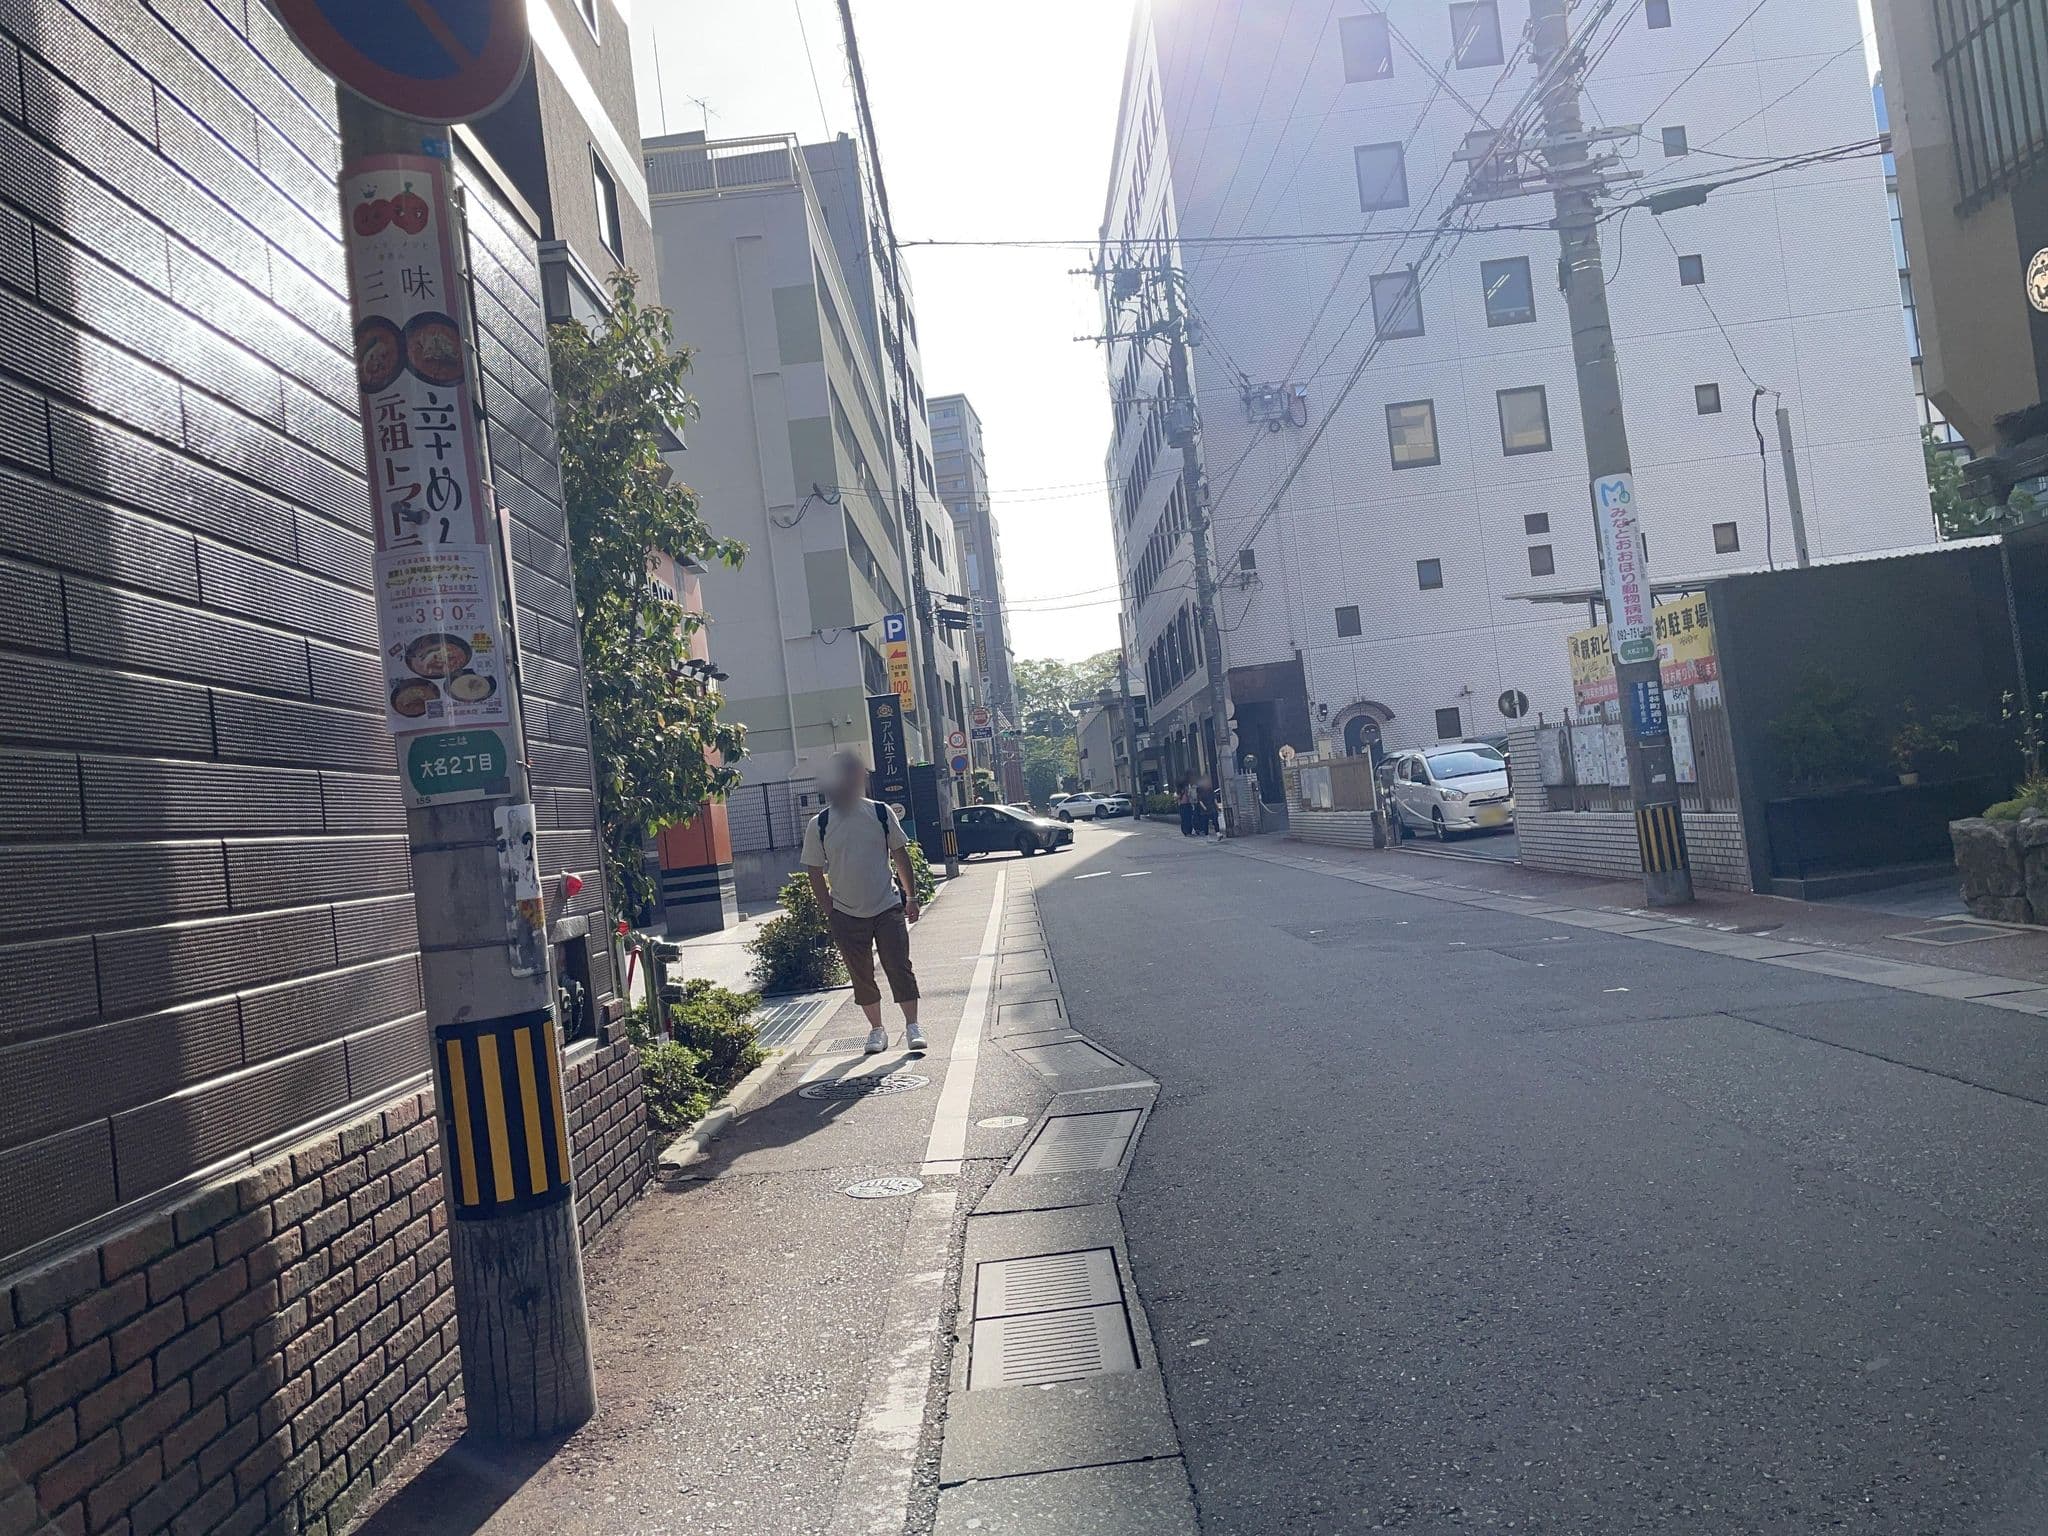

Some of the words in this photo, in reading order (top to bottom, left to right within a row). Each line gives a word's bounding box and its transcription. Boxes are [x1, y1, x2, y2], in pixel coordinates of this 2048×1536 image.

[364, 265, 434, 302] 三味
[1610, 507, 1643, 625] みなとおおほり動物病院
[887, 619, 902, 640] P
[1655, 603, 1708, 640] 約駐車場
[439, 735, 468, 748] ここは
[881, 720, 898, 776] アパホテル
[420, 753, 492, 779] 大名2丁目
